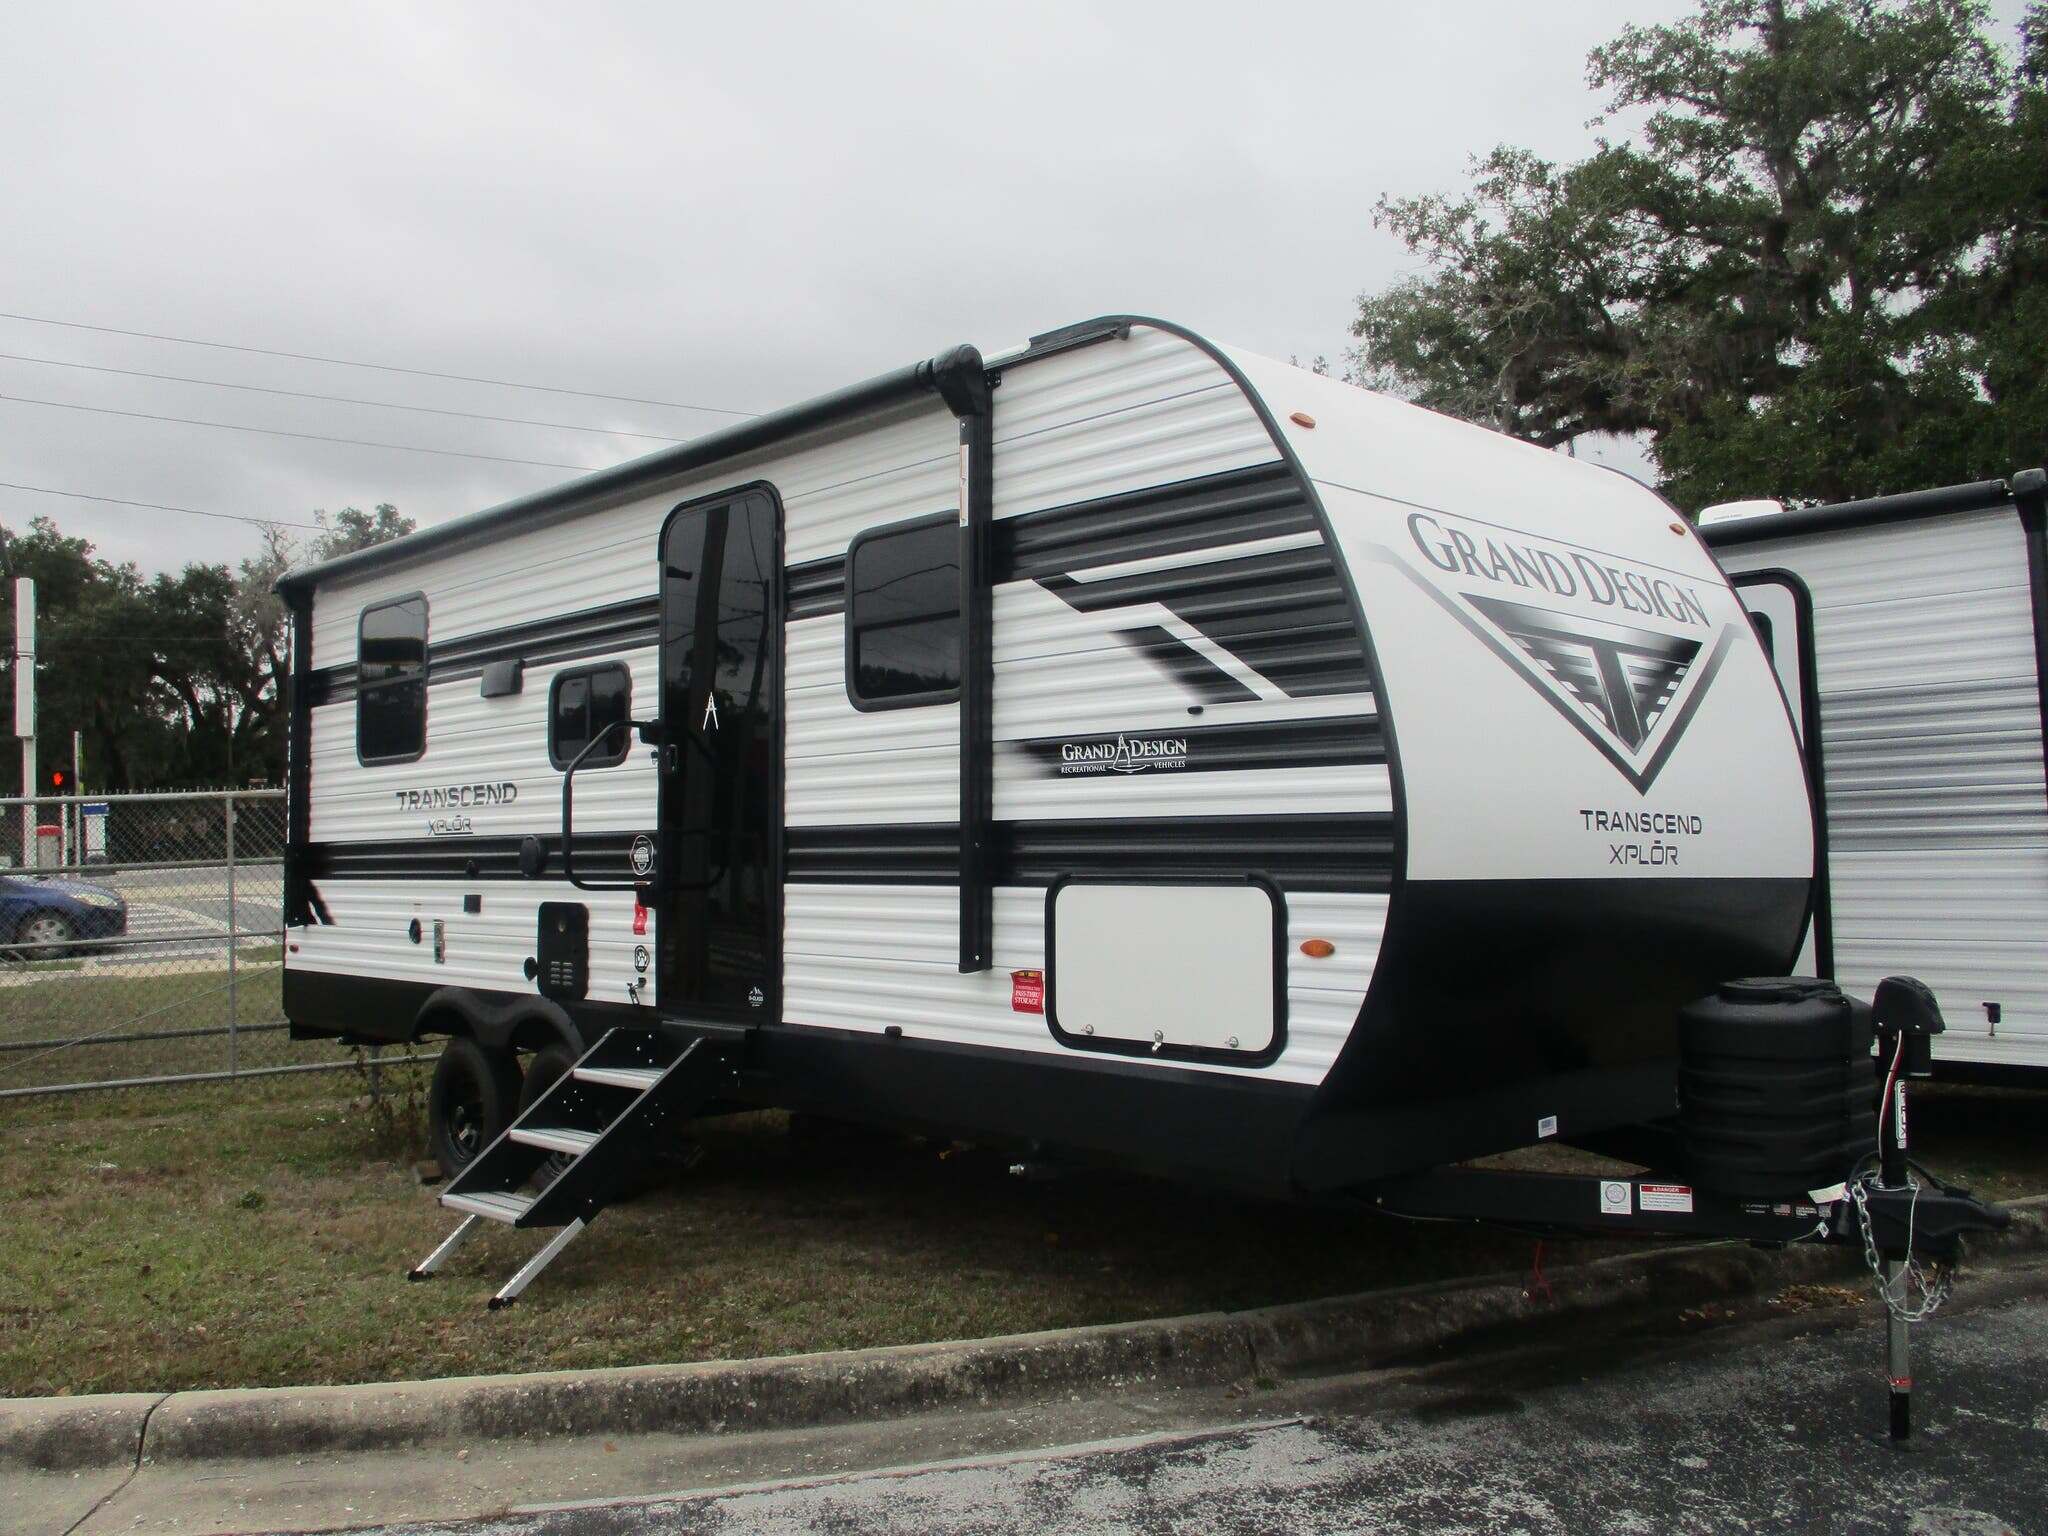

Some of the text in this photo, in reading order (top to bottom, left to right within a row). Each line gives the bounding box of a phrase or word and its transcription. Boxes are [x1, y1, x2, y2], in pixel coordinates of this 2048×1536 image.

[1407, 513, 1711, 628] GRAND DESIGN
[1062, 739, 1187, 761] GRAND DESIGN
[1061, 760, 1186, 774] RECREATIONAL VEHICLES
[396, 782, 518, 811] TRANSCEND
[1579, 809, 1703, 836] TRANSCEND
